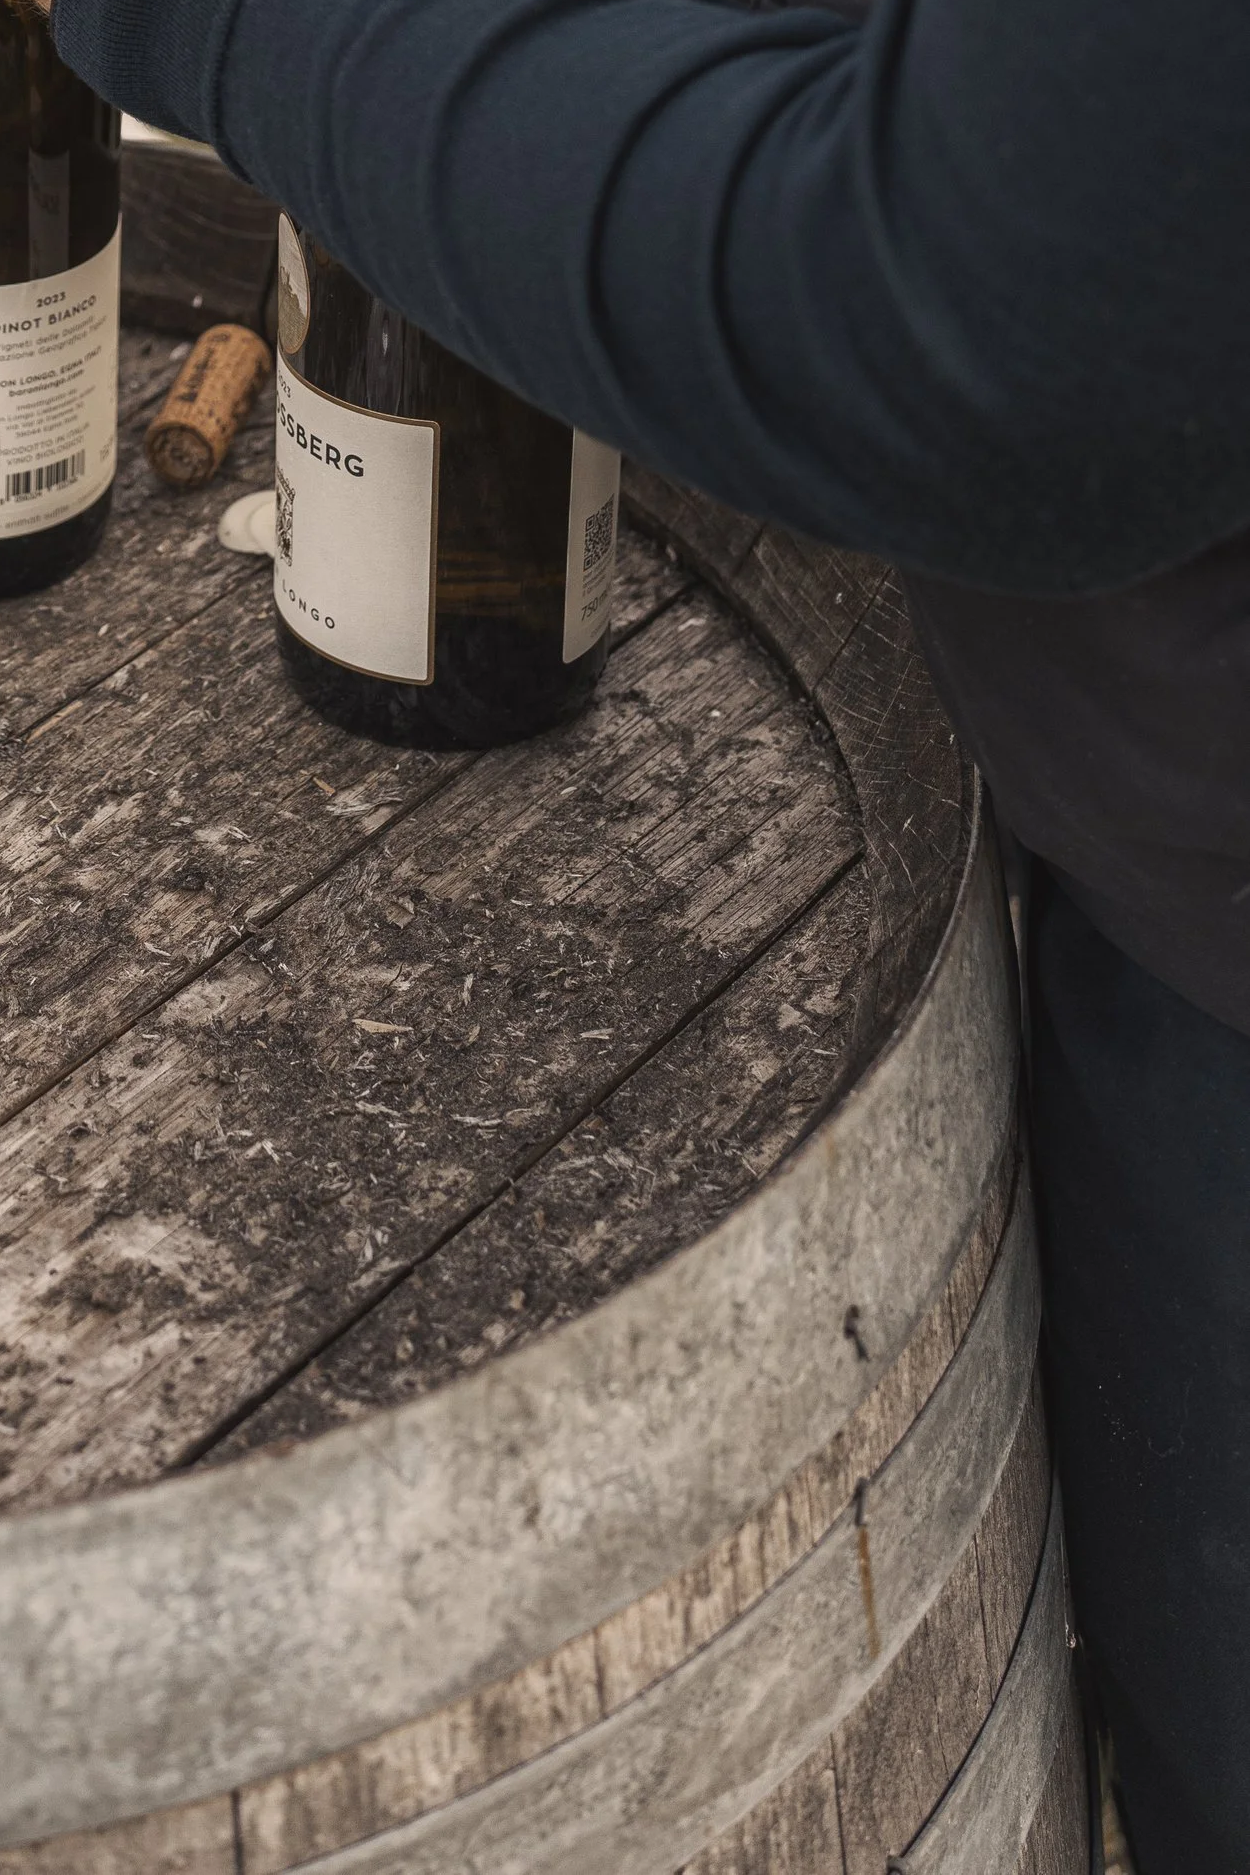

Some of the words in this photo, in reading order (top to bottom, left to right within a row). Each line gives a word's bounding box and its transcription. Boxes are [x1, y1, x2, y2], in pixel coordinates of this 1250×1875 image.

[36, 292, 66, 308] 2023
[48, 295, 97, 325] BIANCO
[282, 579, 335, 629] LONGO
